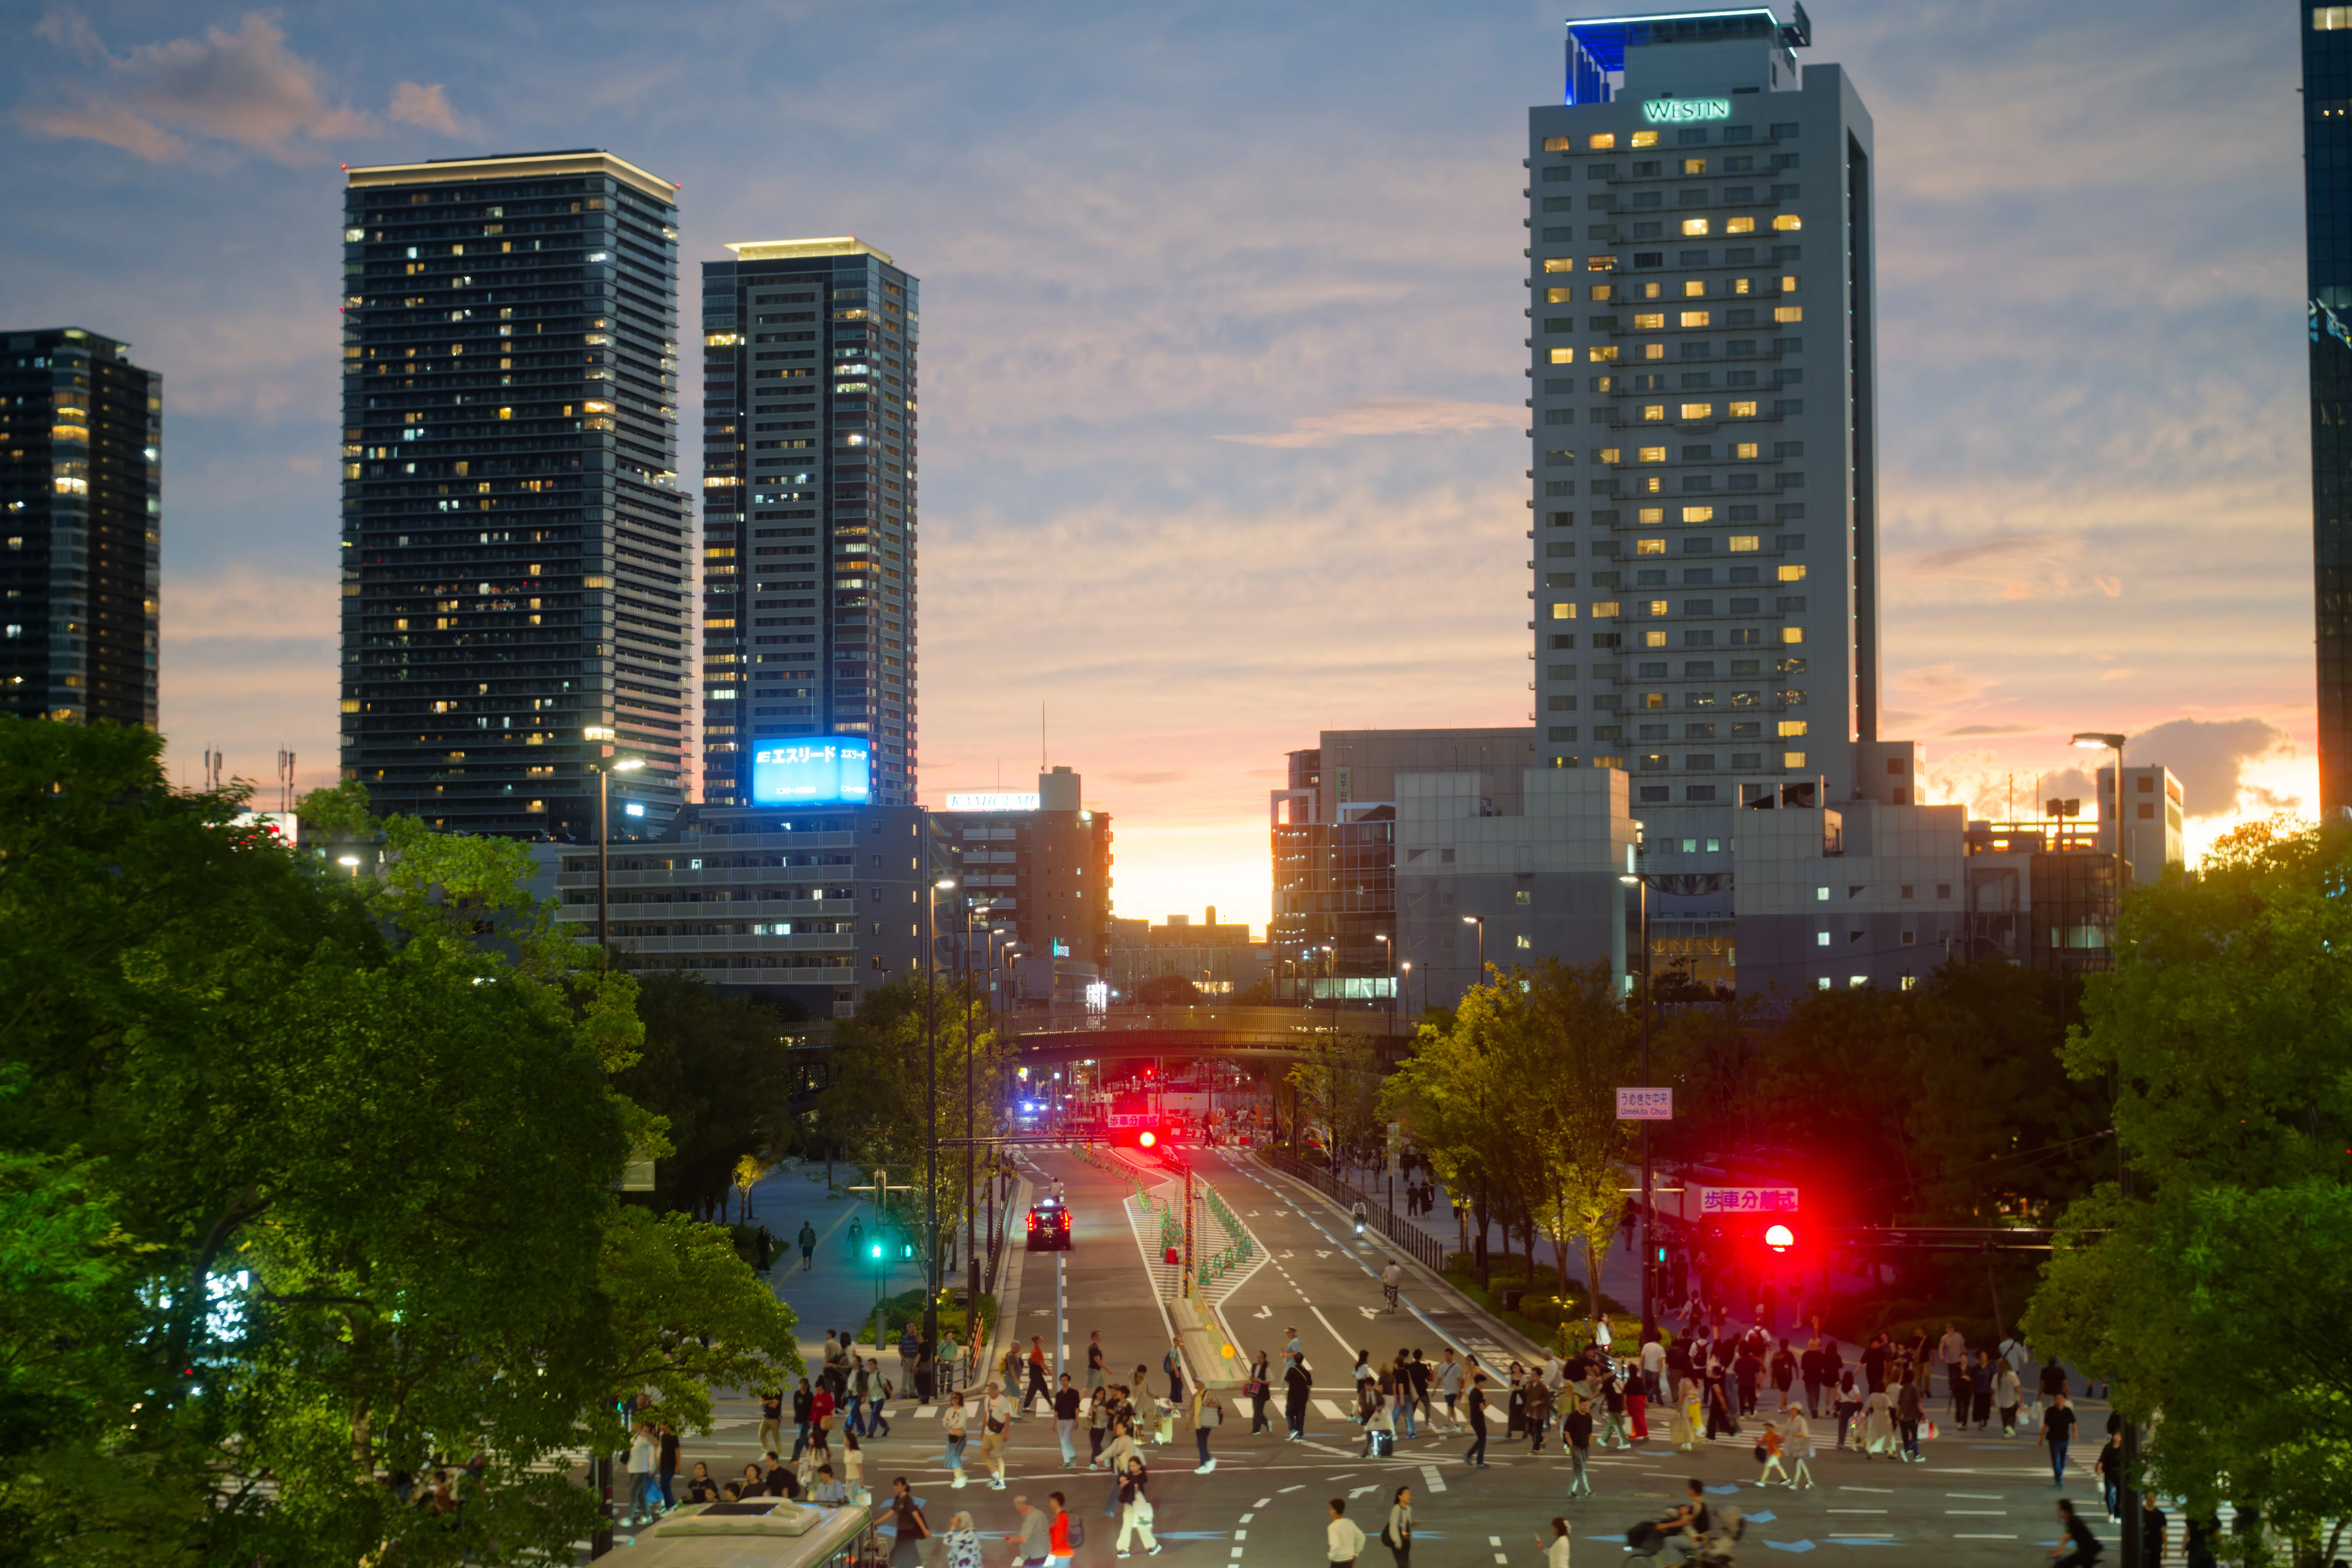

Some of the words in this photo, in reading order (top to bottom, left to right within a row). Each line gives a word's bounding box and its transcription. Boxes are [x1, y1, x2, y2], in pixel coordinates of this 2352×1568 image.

[1645, 100, 1728, 119] WESTIN
[772, 746, 836, 763] エスリード
[1621, 1092, 1667, 1106] うめきた中央
